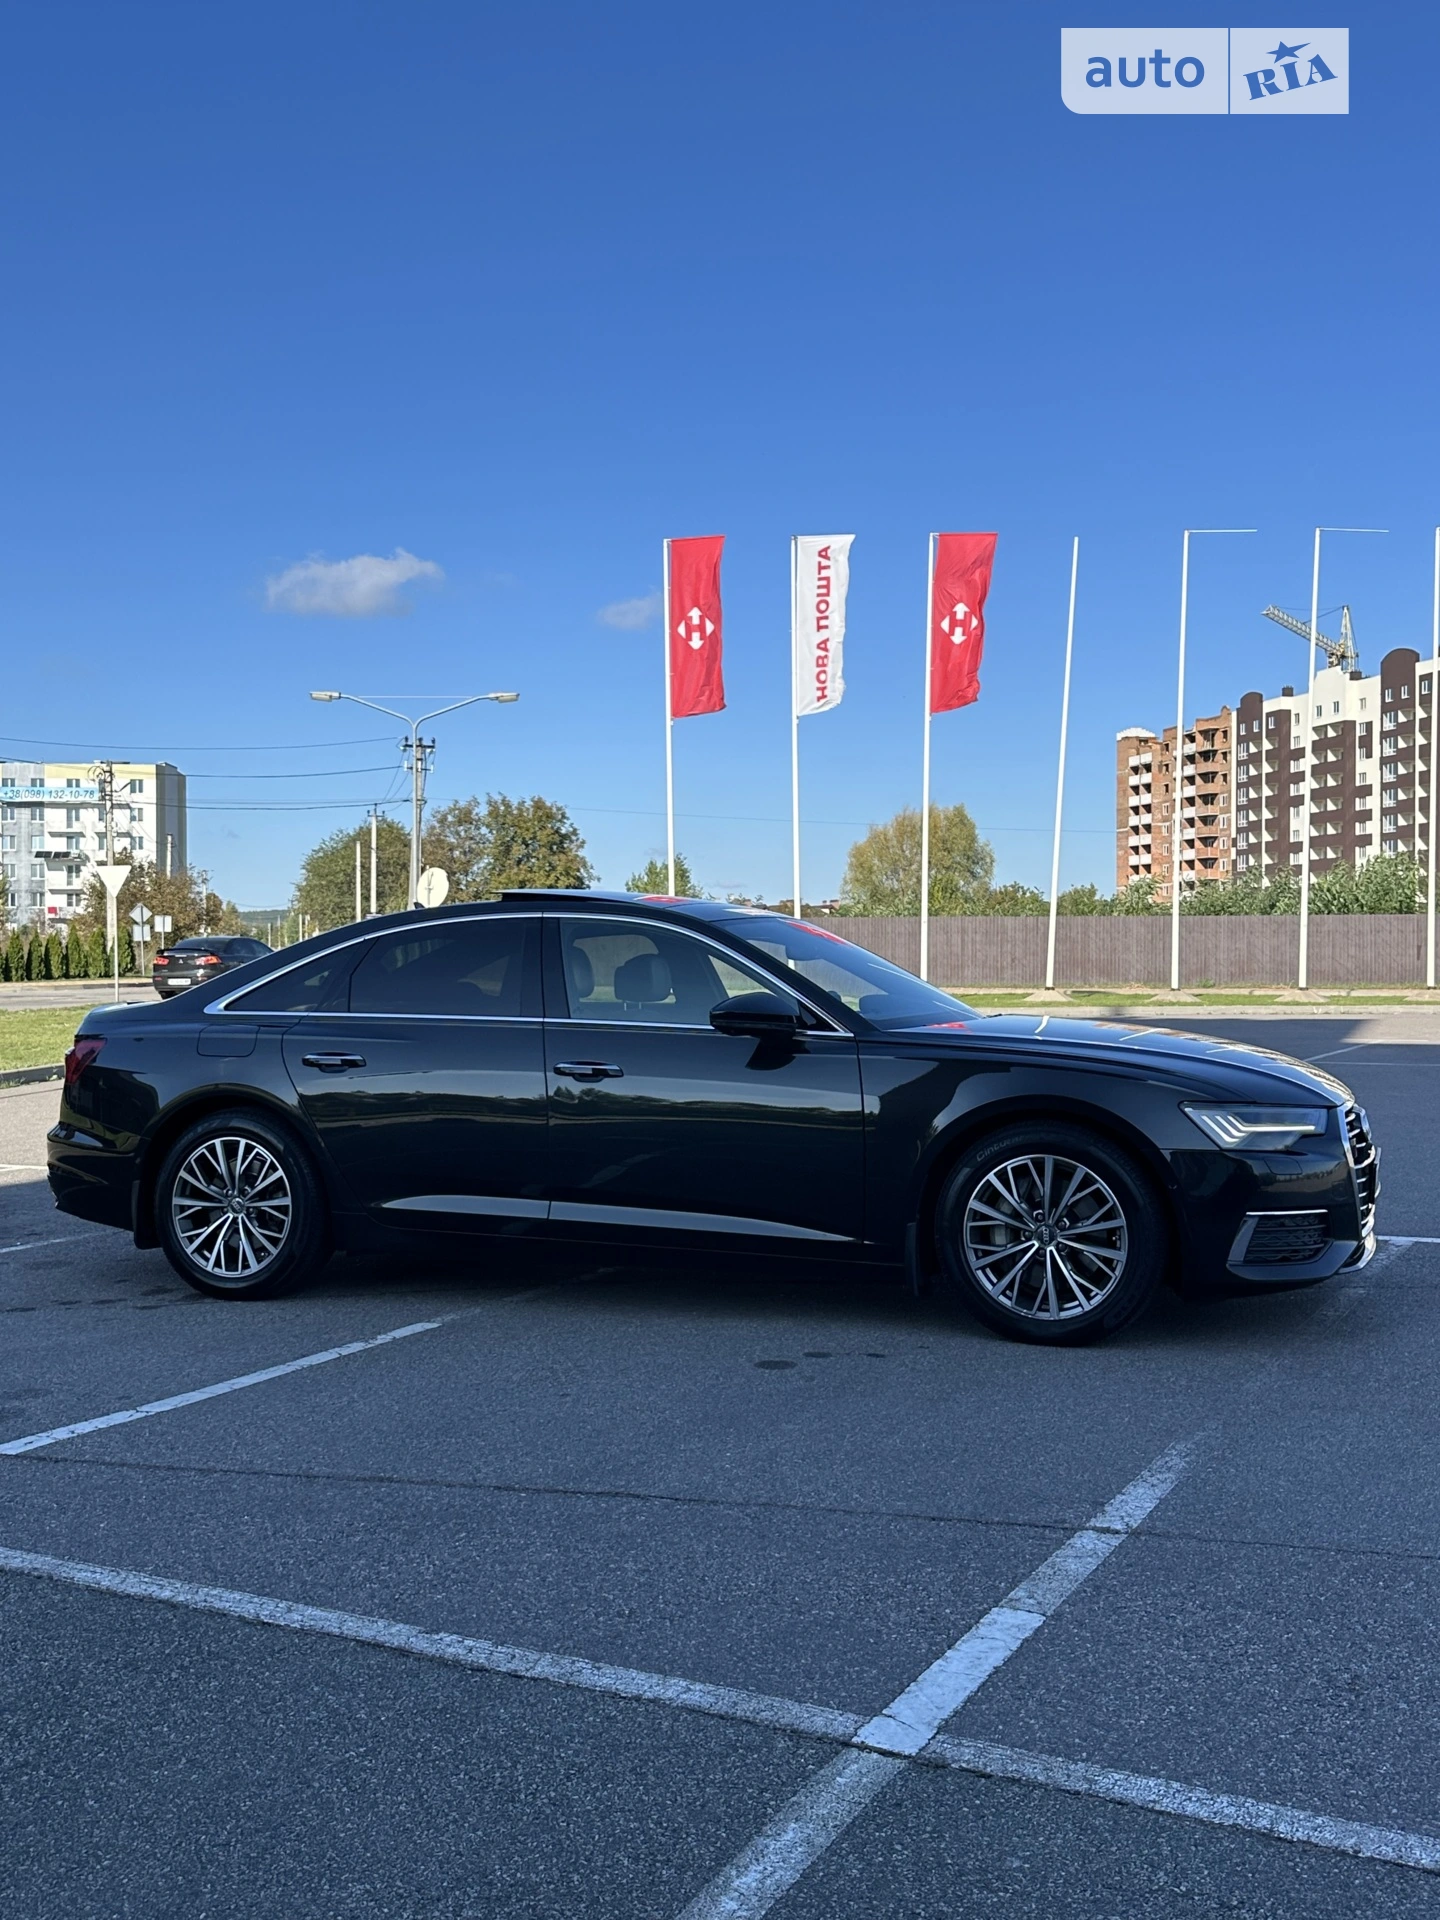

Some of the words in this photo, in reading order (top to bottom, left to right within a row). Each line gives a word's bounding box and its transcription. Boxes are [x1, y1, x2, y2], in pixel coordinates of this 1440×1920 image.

[815, 545, 831, 632] ПОШТА
[815, 637, 830, 702] НОВА
[3, 789, 45, 799] +38(098)
[48, 789, 95, 799] 132-10-78
